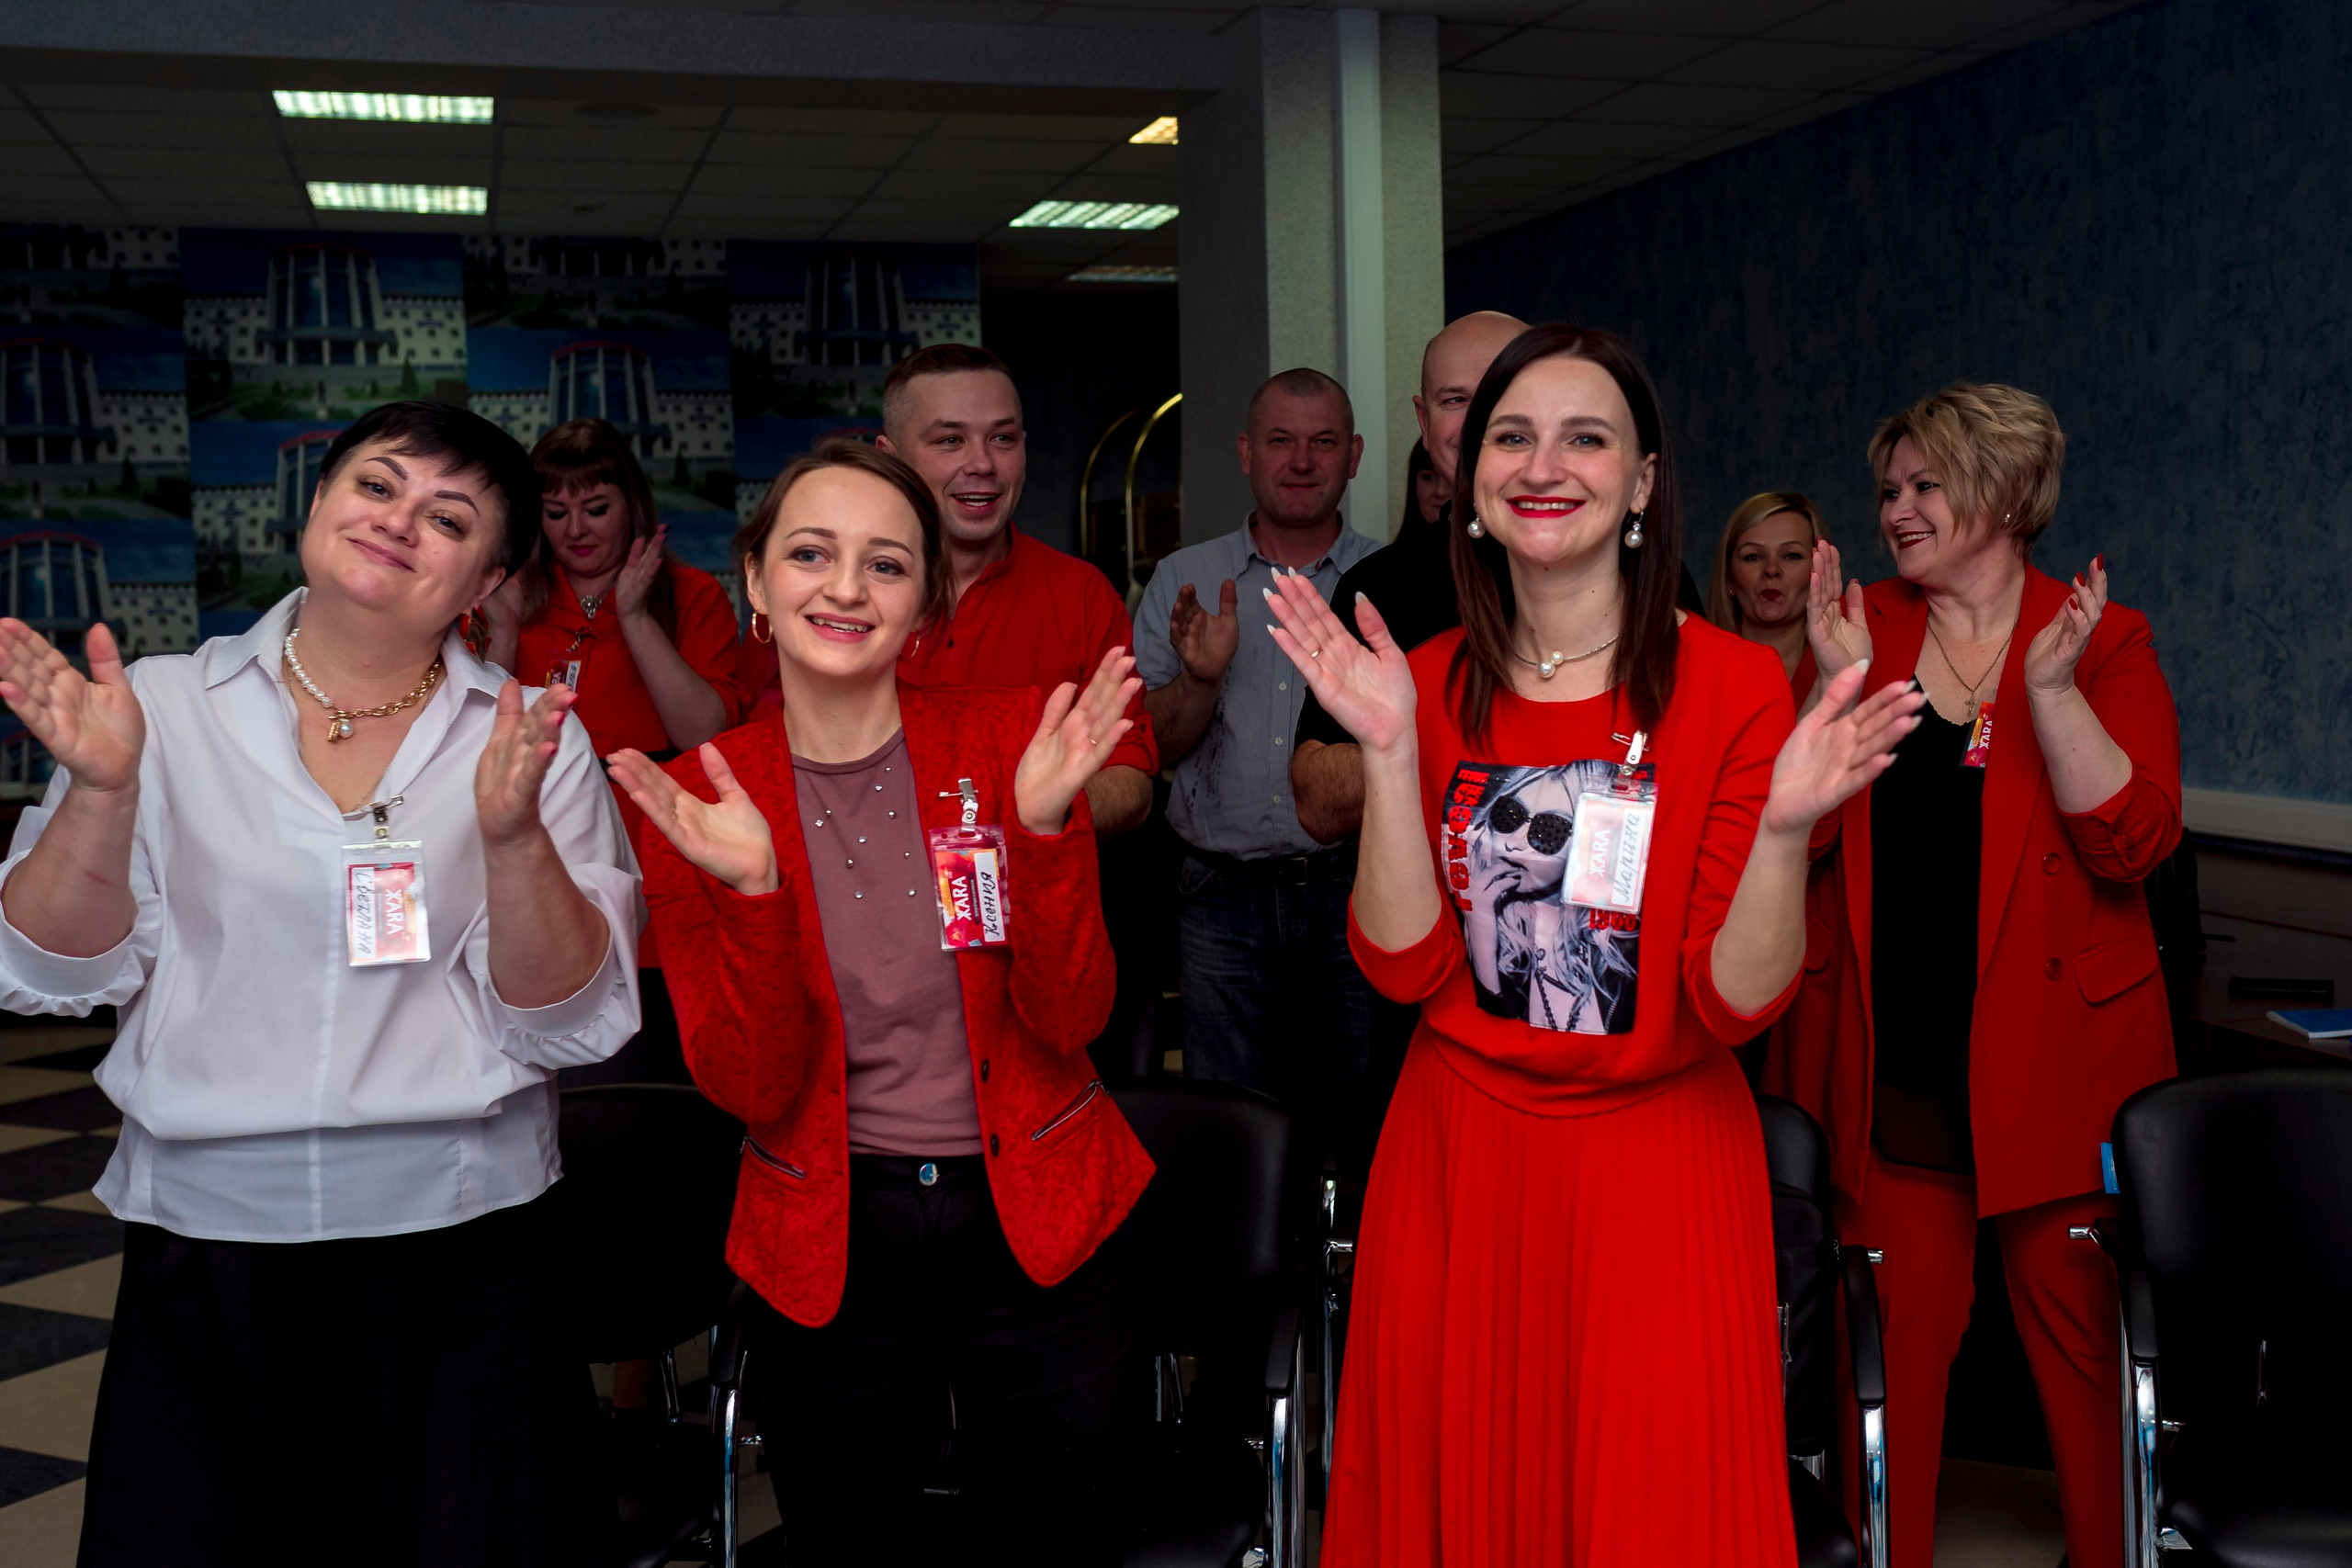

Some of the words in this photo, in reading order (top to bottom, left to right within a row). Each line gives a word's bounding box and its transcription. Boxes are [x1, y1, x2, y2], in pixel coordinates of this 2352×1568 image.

[1448, 769, 1489, 911] reveal
[1613, 813, 1640, 902] Марина
[980, 871, 1000, 936] Ксения
